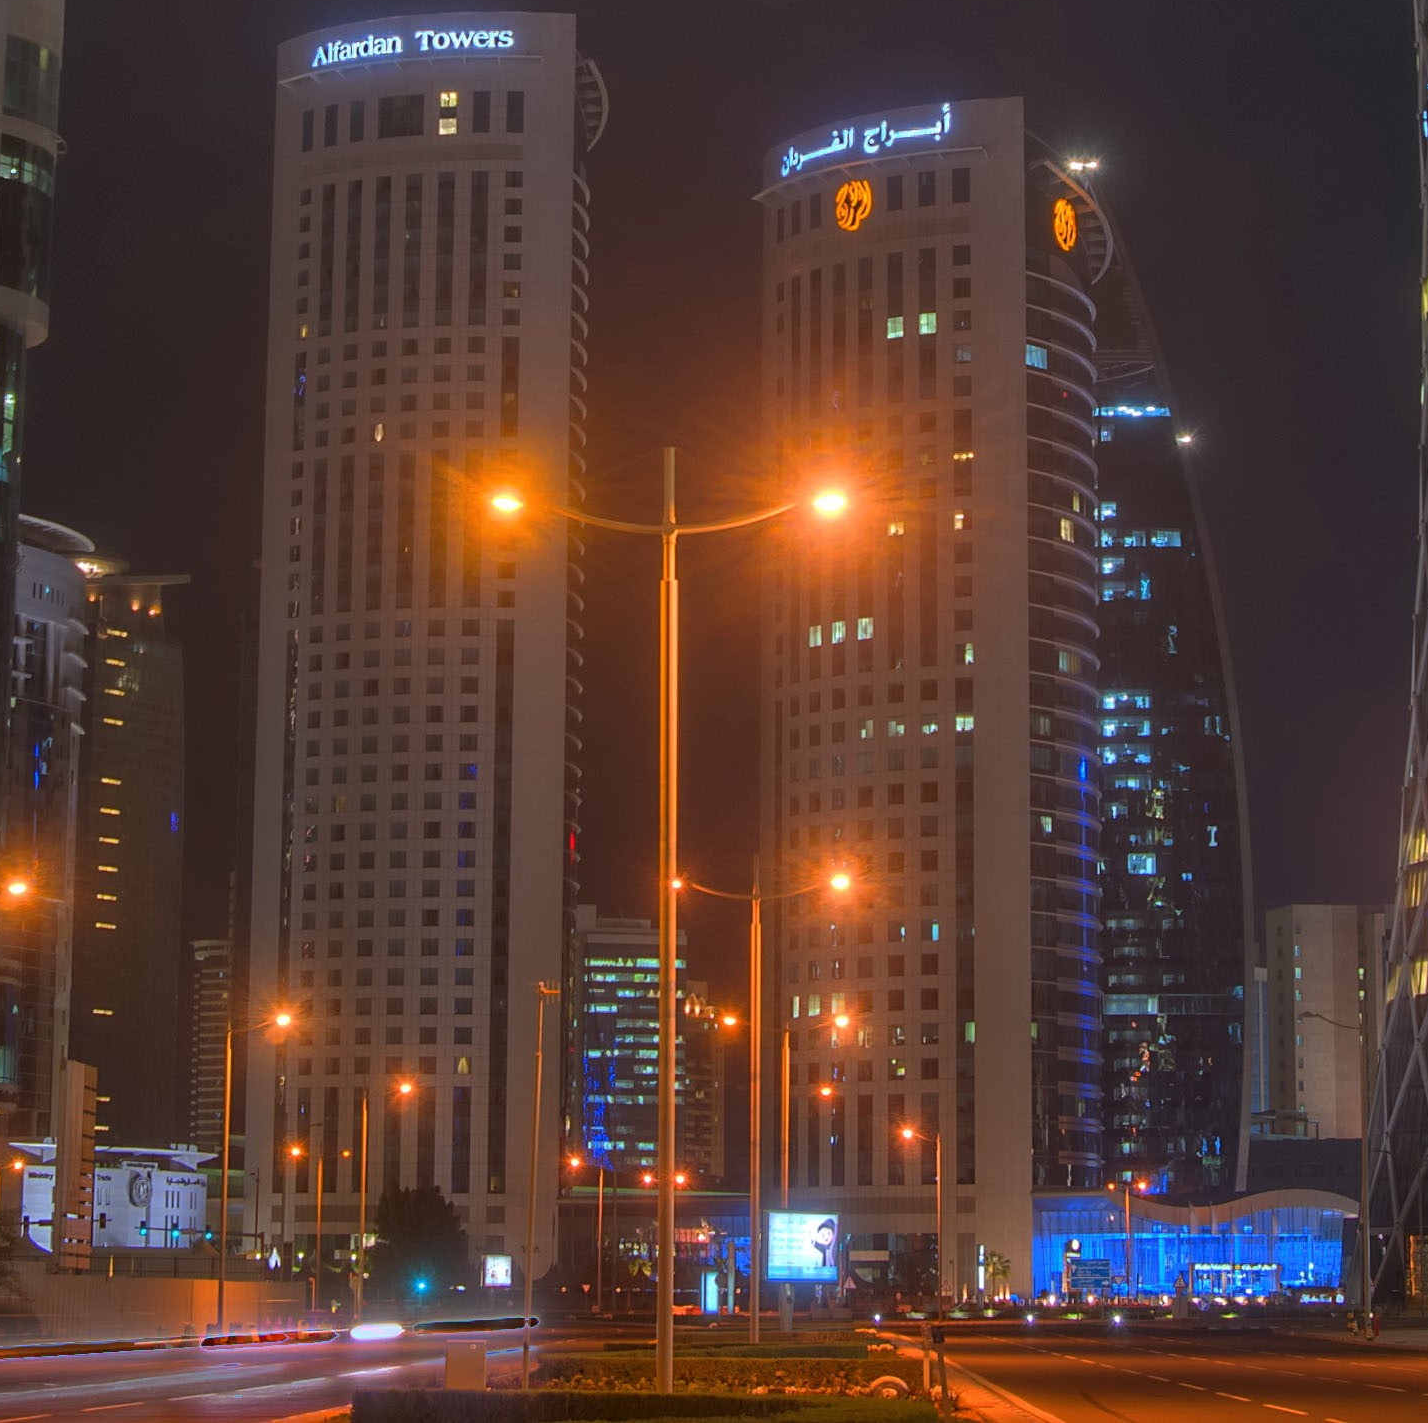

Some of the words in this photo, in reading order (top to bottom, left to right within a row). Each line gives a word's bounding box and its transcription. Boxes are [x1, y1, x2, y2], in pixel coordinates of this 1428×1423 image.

[311, 34, 403, 67] Alfardan
[415, 29, 514, 52] Towers
[780, 127, 854, 177] الفردان
[863, 103, 951, 154] أبراج
